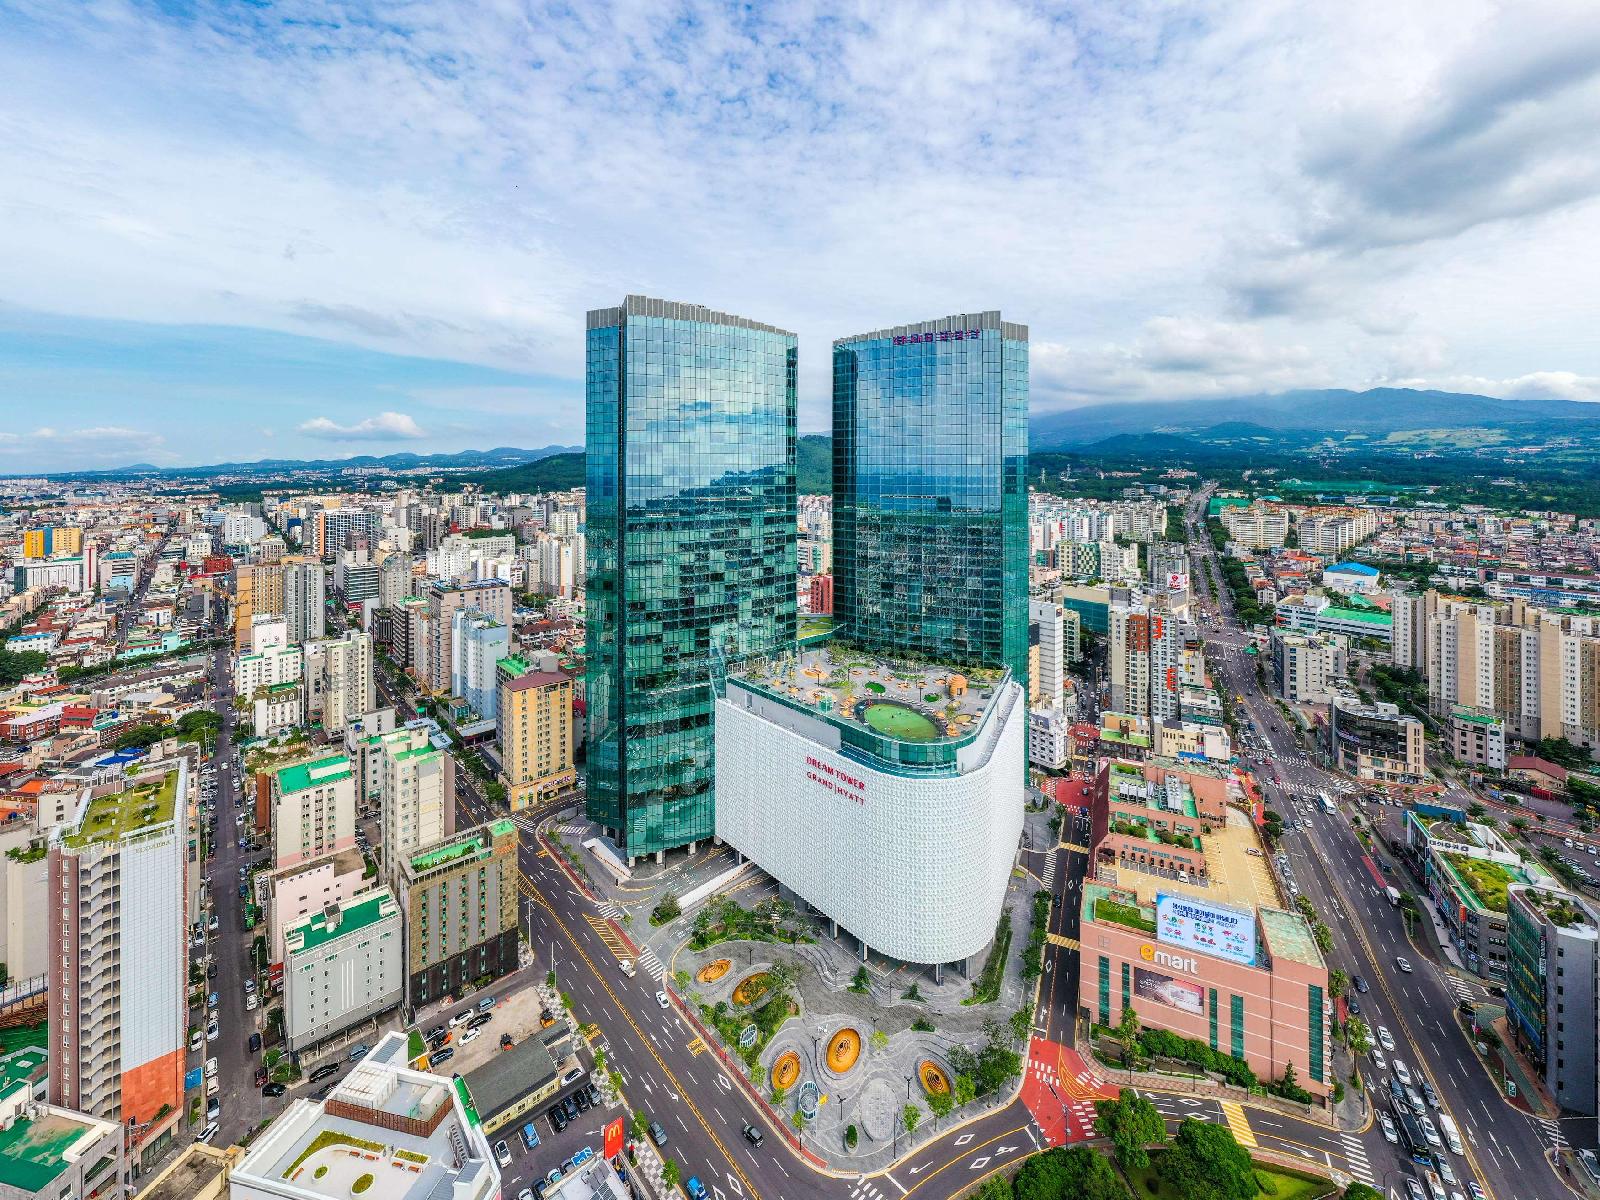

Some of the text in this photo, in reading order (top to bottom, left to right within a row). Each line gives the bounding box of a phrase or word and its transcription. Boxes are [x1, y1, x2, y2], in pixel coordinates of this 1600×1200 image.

[806, 756, 865, 791] DREAM TOWER
[806, 771, 864, 806] GRAND HYATT
[1140, 944, 1198, 974] emart
